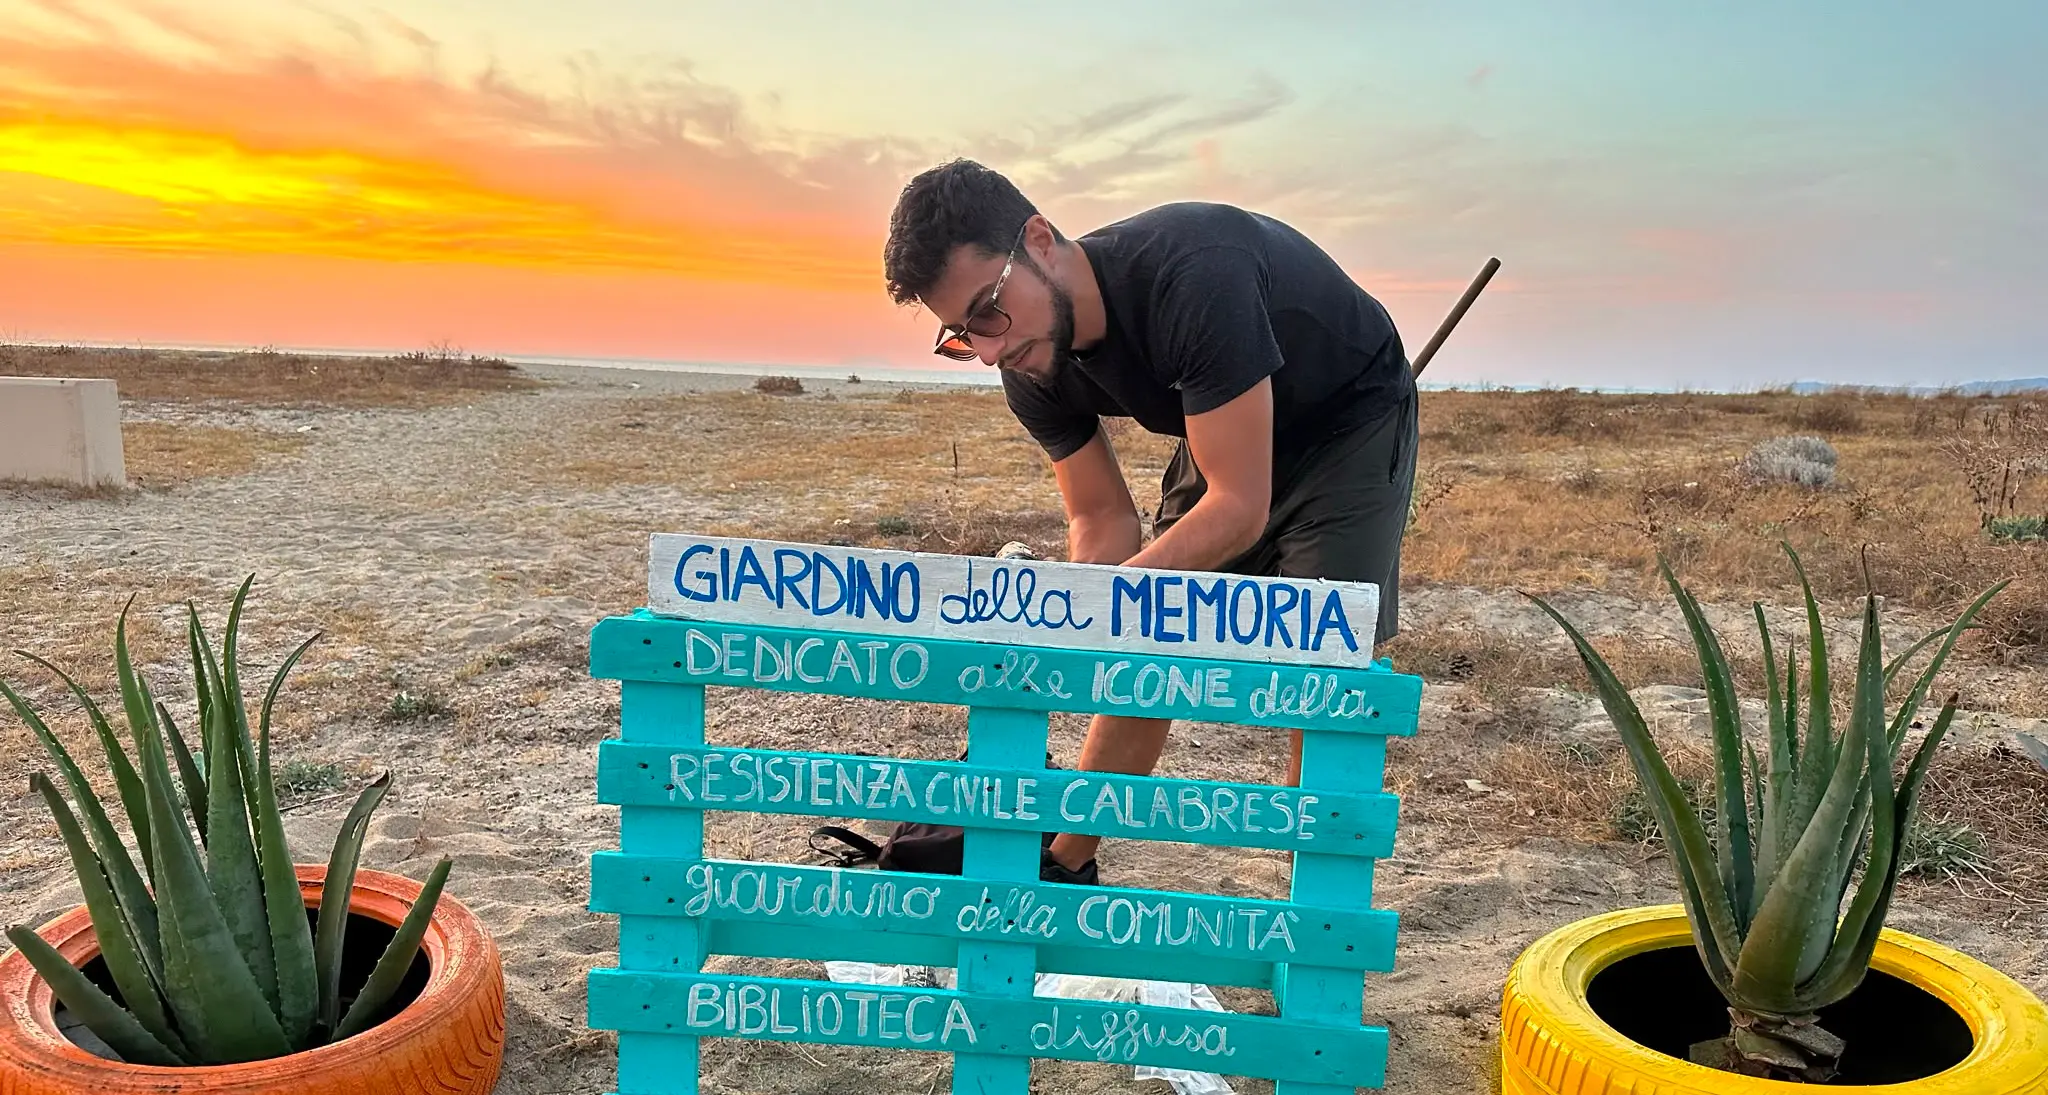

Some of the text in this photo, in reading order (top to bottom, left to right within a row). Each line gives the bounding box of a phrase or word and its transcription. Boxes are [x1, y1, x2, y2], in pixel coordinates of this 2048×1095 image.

[674, 544, 1359, 653] GIARDINO della MEMORIA
[685, 629, 1374, 719] DEDICATO alle ICONE della
[669, 754, 1319, 840] RESISTENZA CIVILE CALABRESE
[685, 864, 941, 918] giardino
[957, 886, 1059, 938] della
[1030, 1006, 1236, 1061] diffusa
